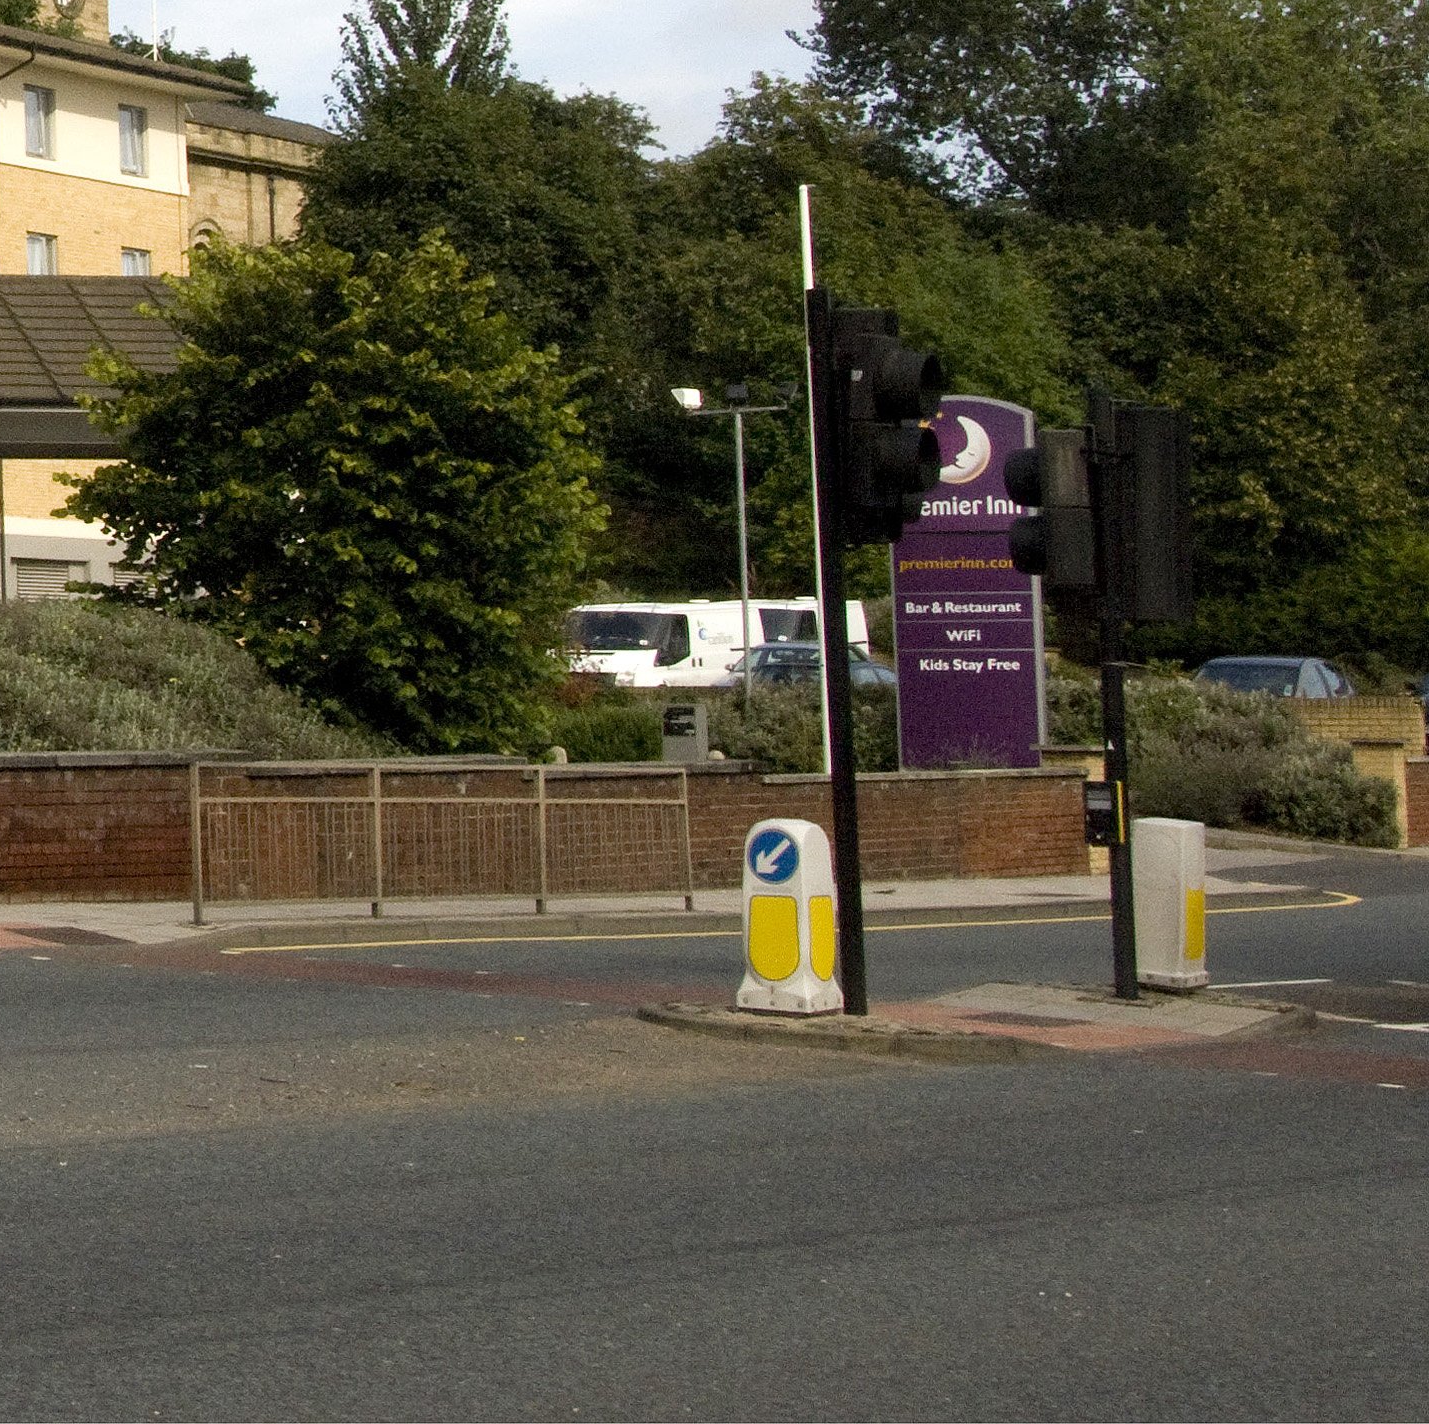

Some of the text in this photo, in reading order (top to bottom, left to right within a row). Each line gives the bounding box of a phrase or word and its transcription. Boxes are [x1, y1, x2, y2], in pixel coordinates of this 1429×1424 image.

[921, 496, 982, 516] emier
[905, 601, 1021, 614] Bar & Restaurant
[946, 630, 981, 641] WiFi
[920, 658, 1020, 673] Kids Stay Free
